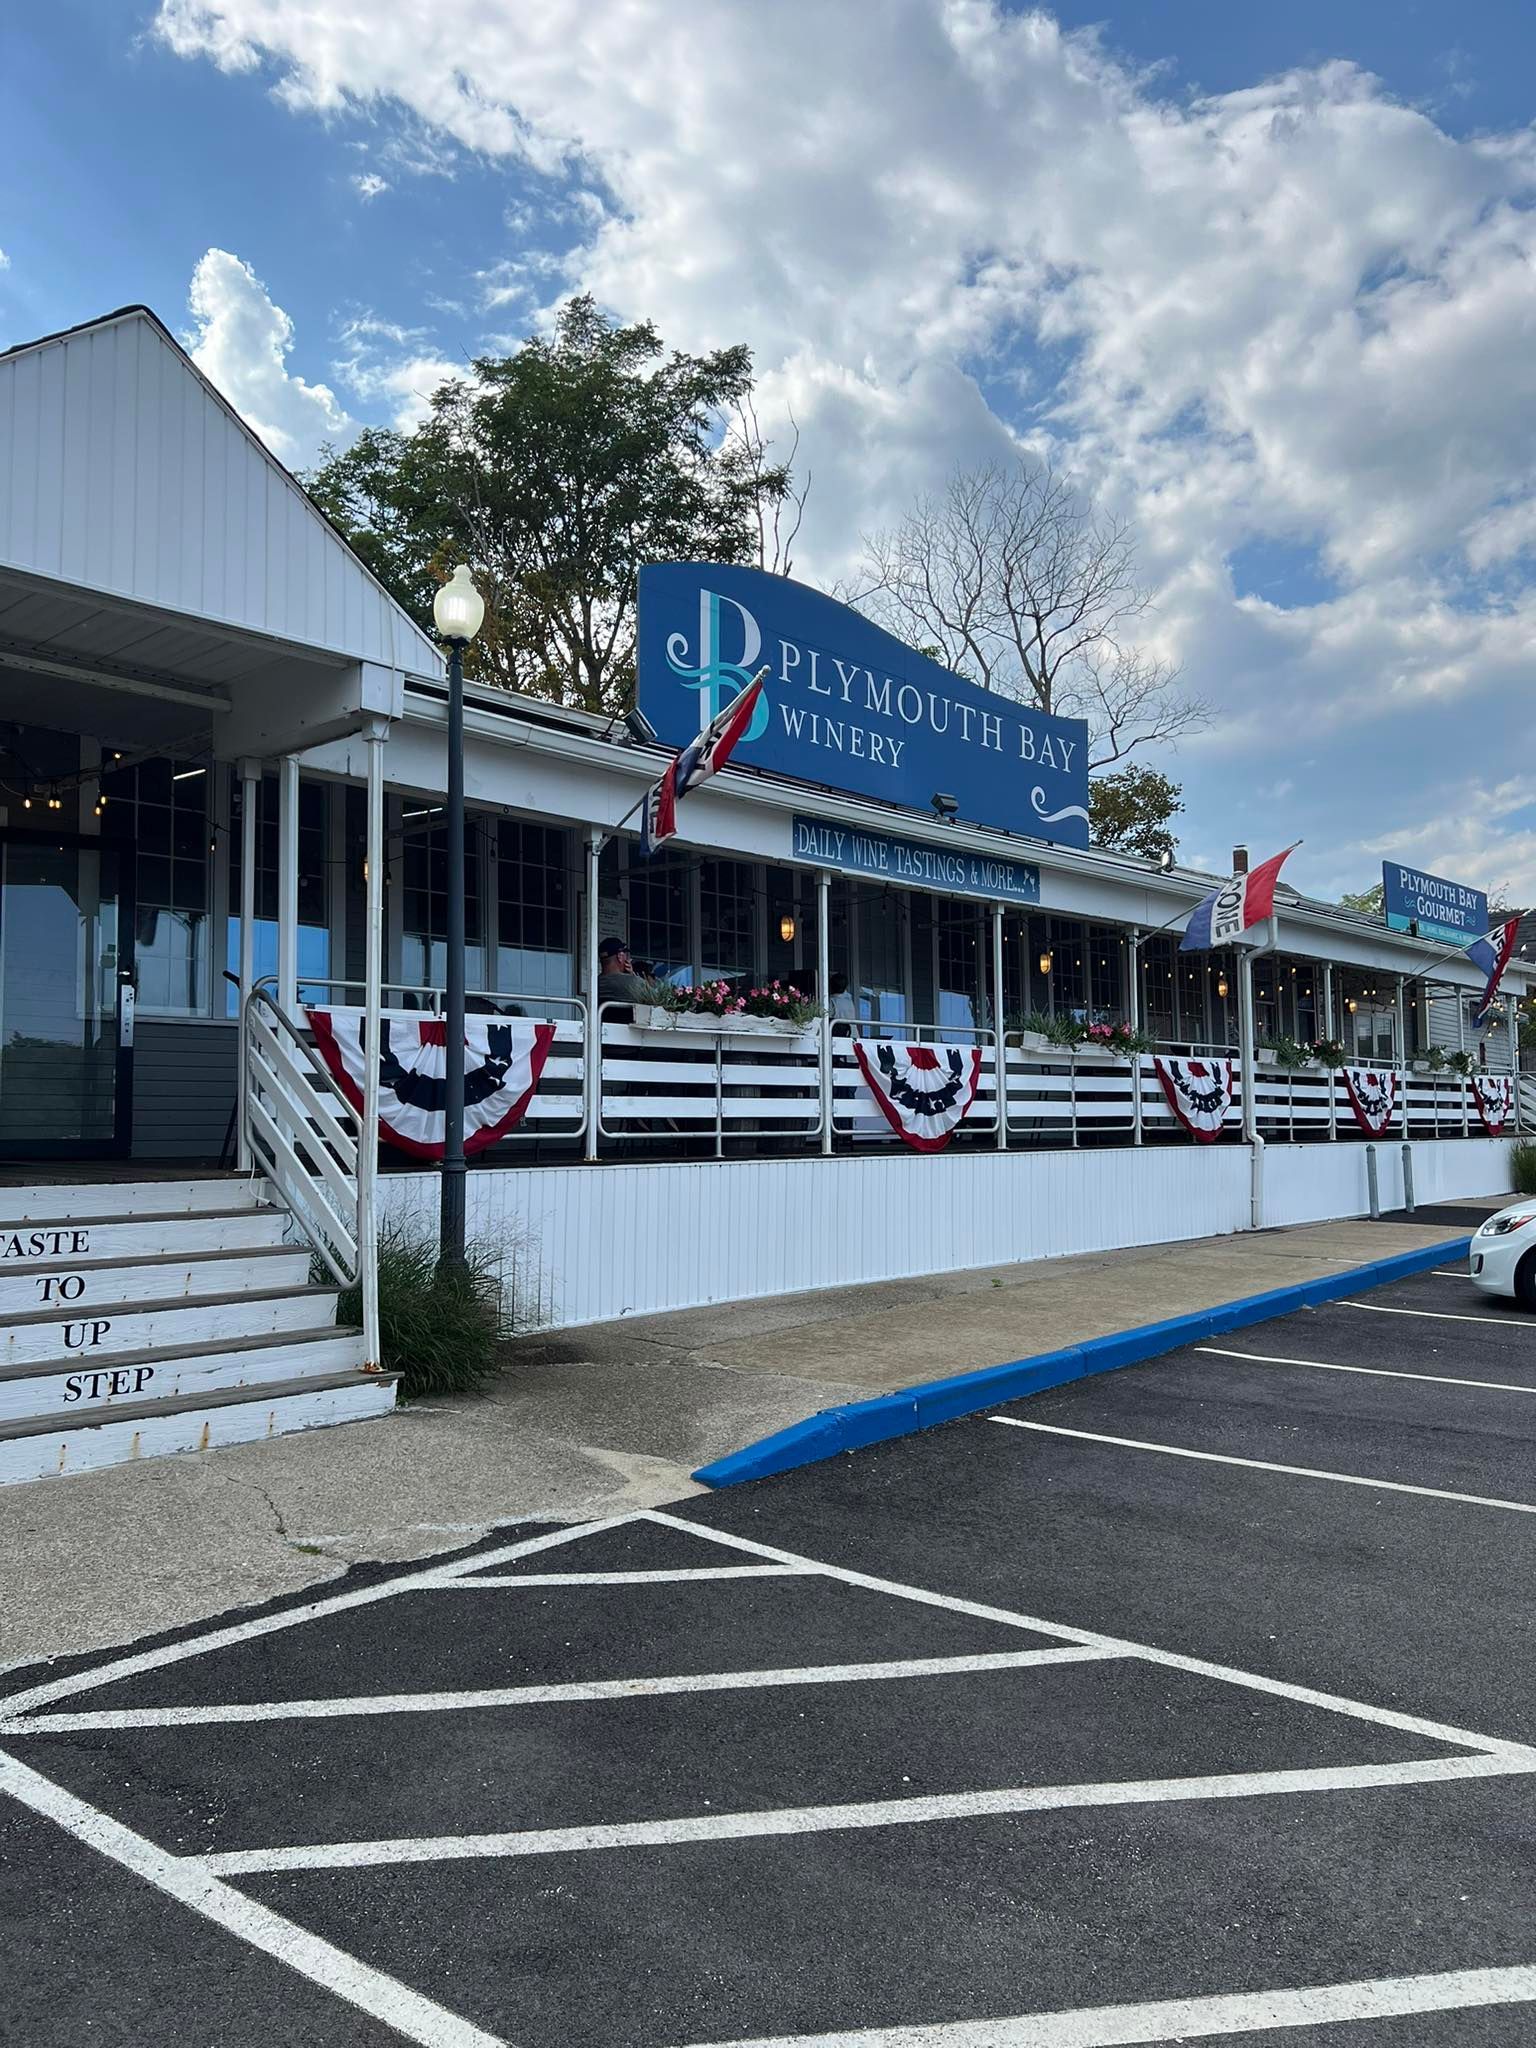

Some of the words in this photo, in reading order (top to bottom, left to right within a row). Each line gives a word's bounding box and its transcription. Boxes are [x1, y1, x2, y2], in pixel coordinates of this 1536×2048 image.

[778, 639, 1003, 752] PLYMOUTH
[1018, 724, 1077, 773] BAY
[778, 703, 905, 768] WINERY
[798, 823, 845, 861] DAILY
[851, 835, 889, 870] WINE
[894, 845, 966, 884] TASTINGS
[970, 861, 979, 886] &
[980, 860, 1025, 894] MORE...
[1400, 868, 1456, 904] PLYMOUTH
[1458, 887, 1478, 910] BAY
[1417, 896, 1466, 926] GOURMET
[0, 1230, 90, 1258] ASTE
[36, 1275, 86, 1302] TO
[61, 1320, 111, 1349] UP
[62, 1366, 155, 1402] STEP
